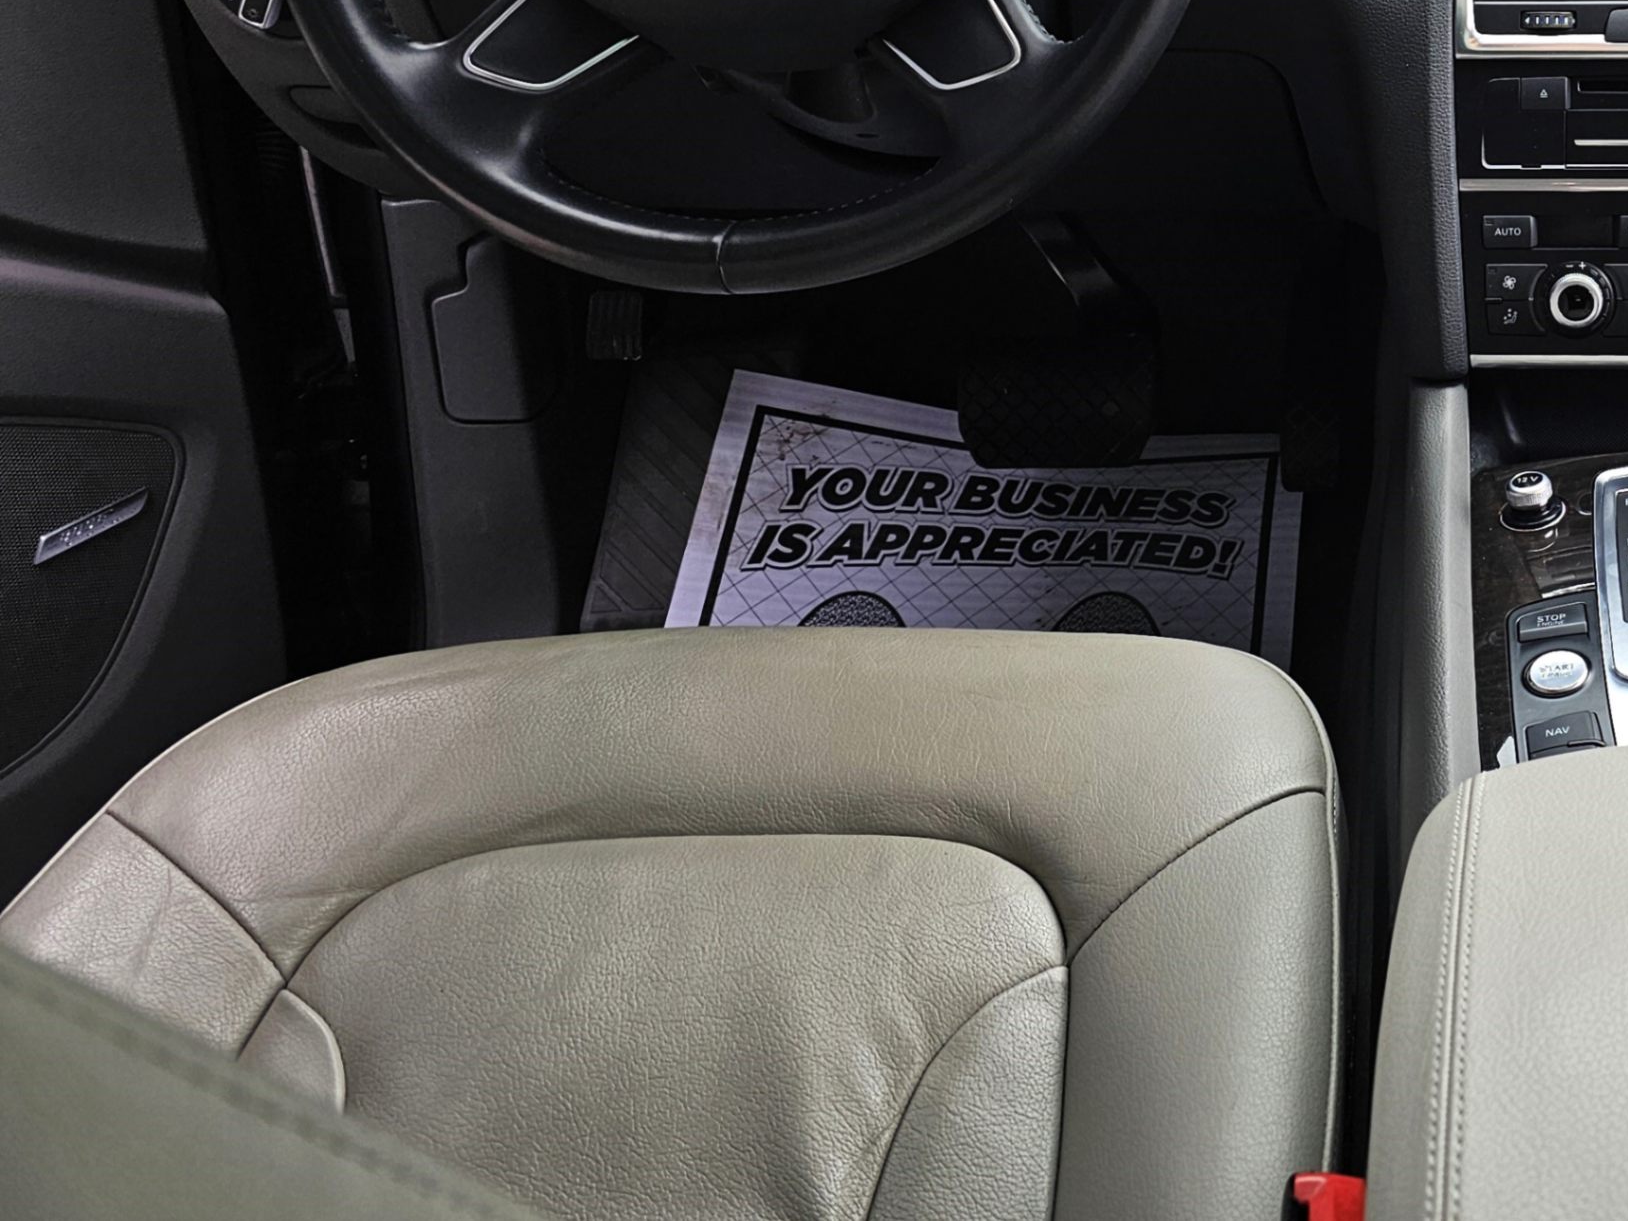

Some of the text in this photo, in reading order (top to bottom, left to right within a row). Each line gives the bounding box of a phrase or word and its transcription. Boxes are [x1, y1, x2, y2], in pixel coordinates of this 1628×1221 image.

[1494, 227, 1521, 236] AUTO
[783, 465, 1235, 526] YOUR BUSINESS
[744, 522, 1242, 577] IS APPRECIATED!
[1536, 613, 1566, 623] STOP
[1545, 726, 1570, 737] NAV
